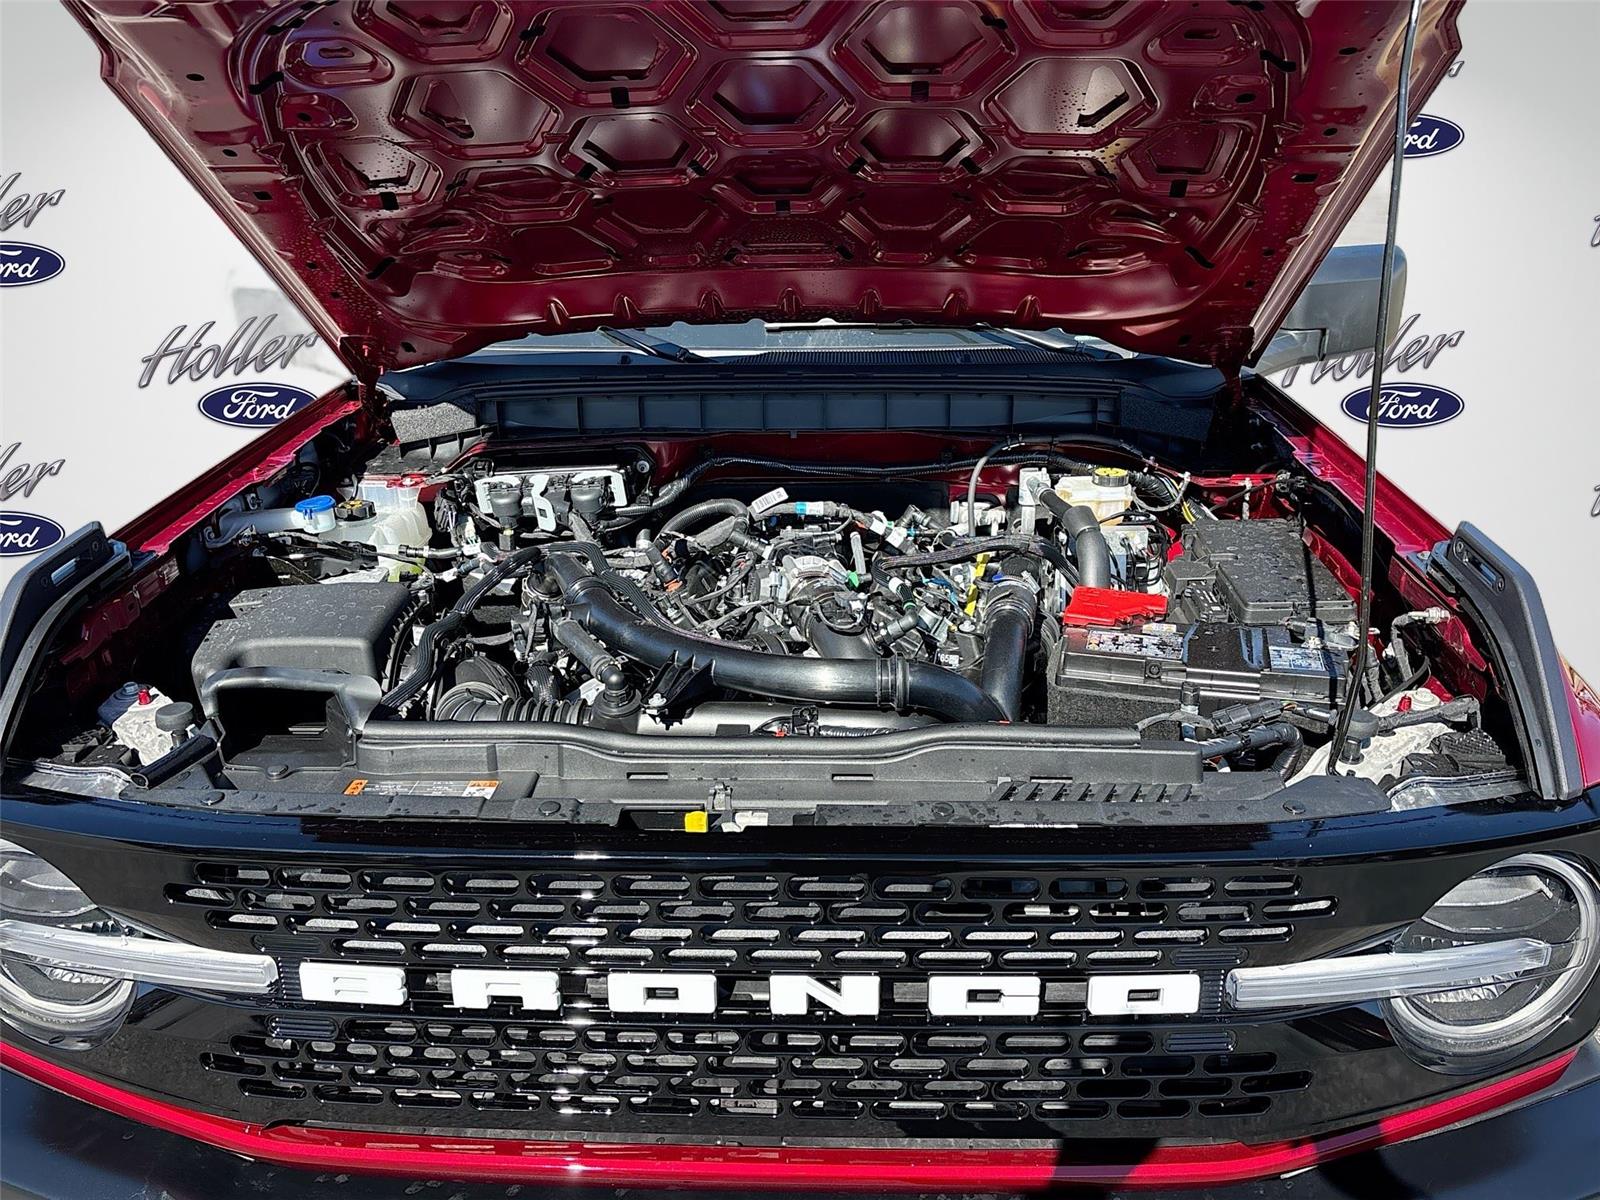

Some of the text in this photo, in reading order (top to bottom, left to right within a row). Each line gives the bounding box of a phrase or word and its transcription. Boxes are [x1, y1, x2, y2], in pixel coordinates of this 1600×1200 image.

[1404, 121, 1439, 149] rd
[0, 249, 40, 278] rd
[138, 314, 321, 389] Holler
[223, 390, 297, 419] Ford
[1365, 390, 1440, 419] Ford
[0, 520, 40, 548] rd
[299, 961, 1200, 1016] BRONCO
